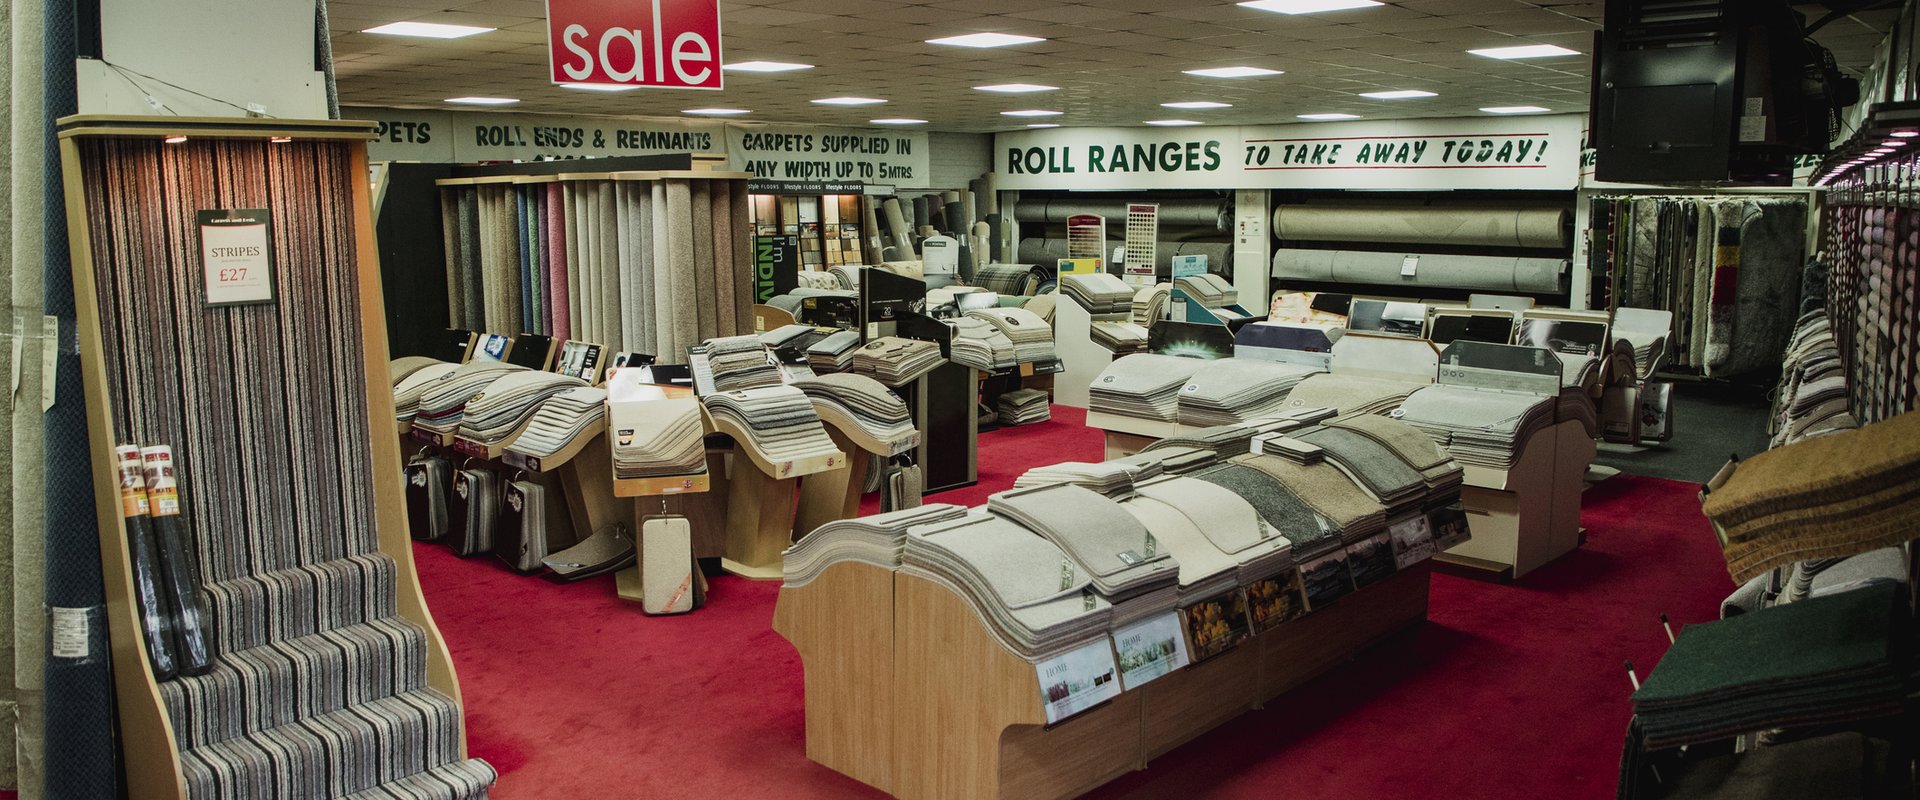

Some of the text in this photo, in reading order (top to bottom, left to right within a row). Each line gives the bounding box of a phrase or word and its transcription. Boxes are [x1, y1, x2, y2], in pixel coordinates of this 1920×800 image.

[562, 0, 712, 85] sale
[369, 121, 431, 144] PETS
[475, 125, 711, 150] ROLL ENDS & REMNANTS
[742, 133, 912, 155] CARPETS SUPPLIED IN
[1008, 140, 1222, 175] ROLL RANGES
[1244, 139, 1547, 166] TO TAKE AWAY TODAY!
[744, 160, 778, 178] ANY
[784, 161, 831, 178] WIDTH
[836, 161, 854, 178] UP
[857, 162, 874, 178] TO
[211, 246, 260, 258] STRIPES
[219, 268, 247, 282] £27
[758, 237, 775, 301] INDIV
[1046, 663, 1069, 679] HOME
